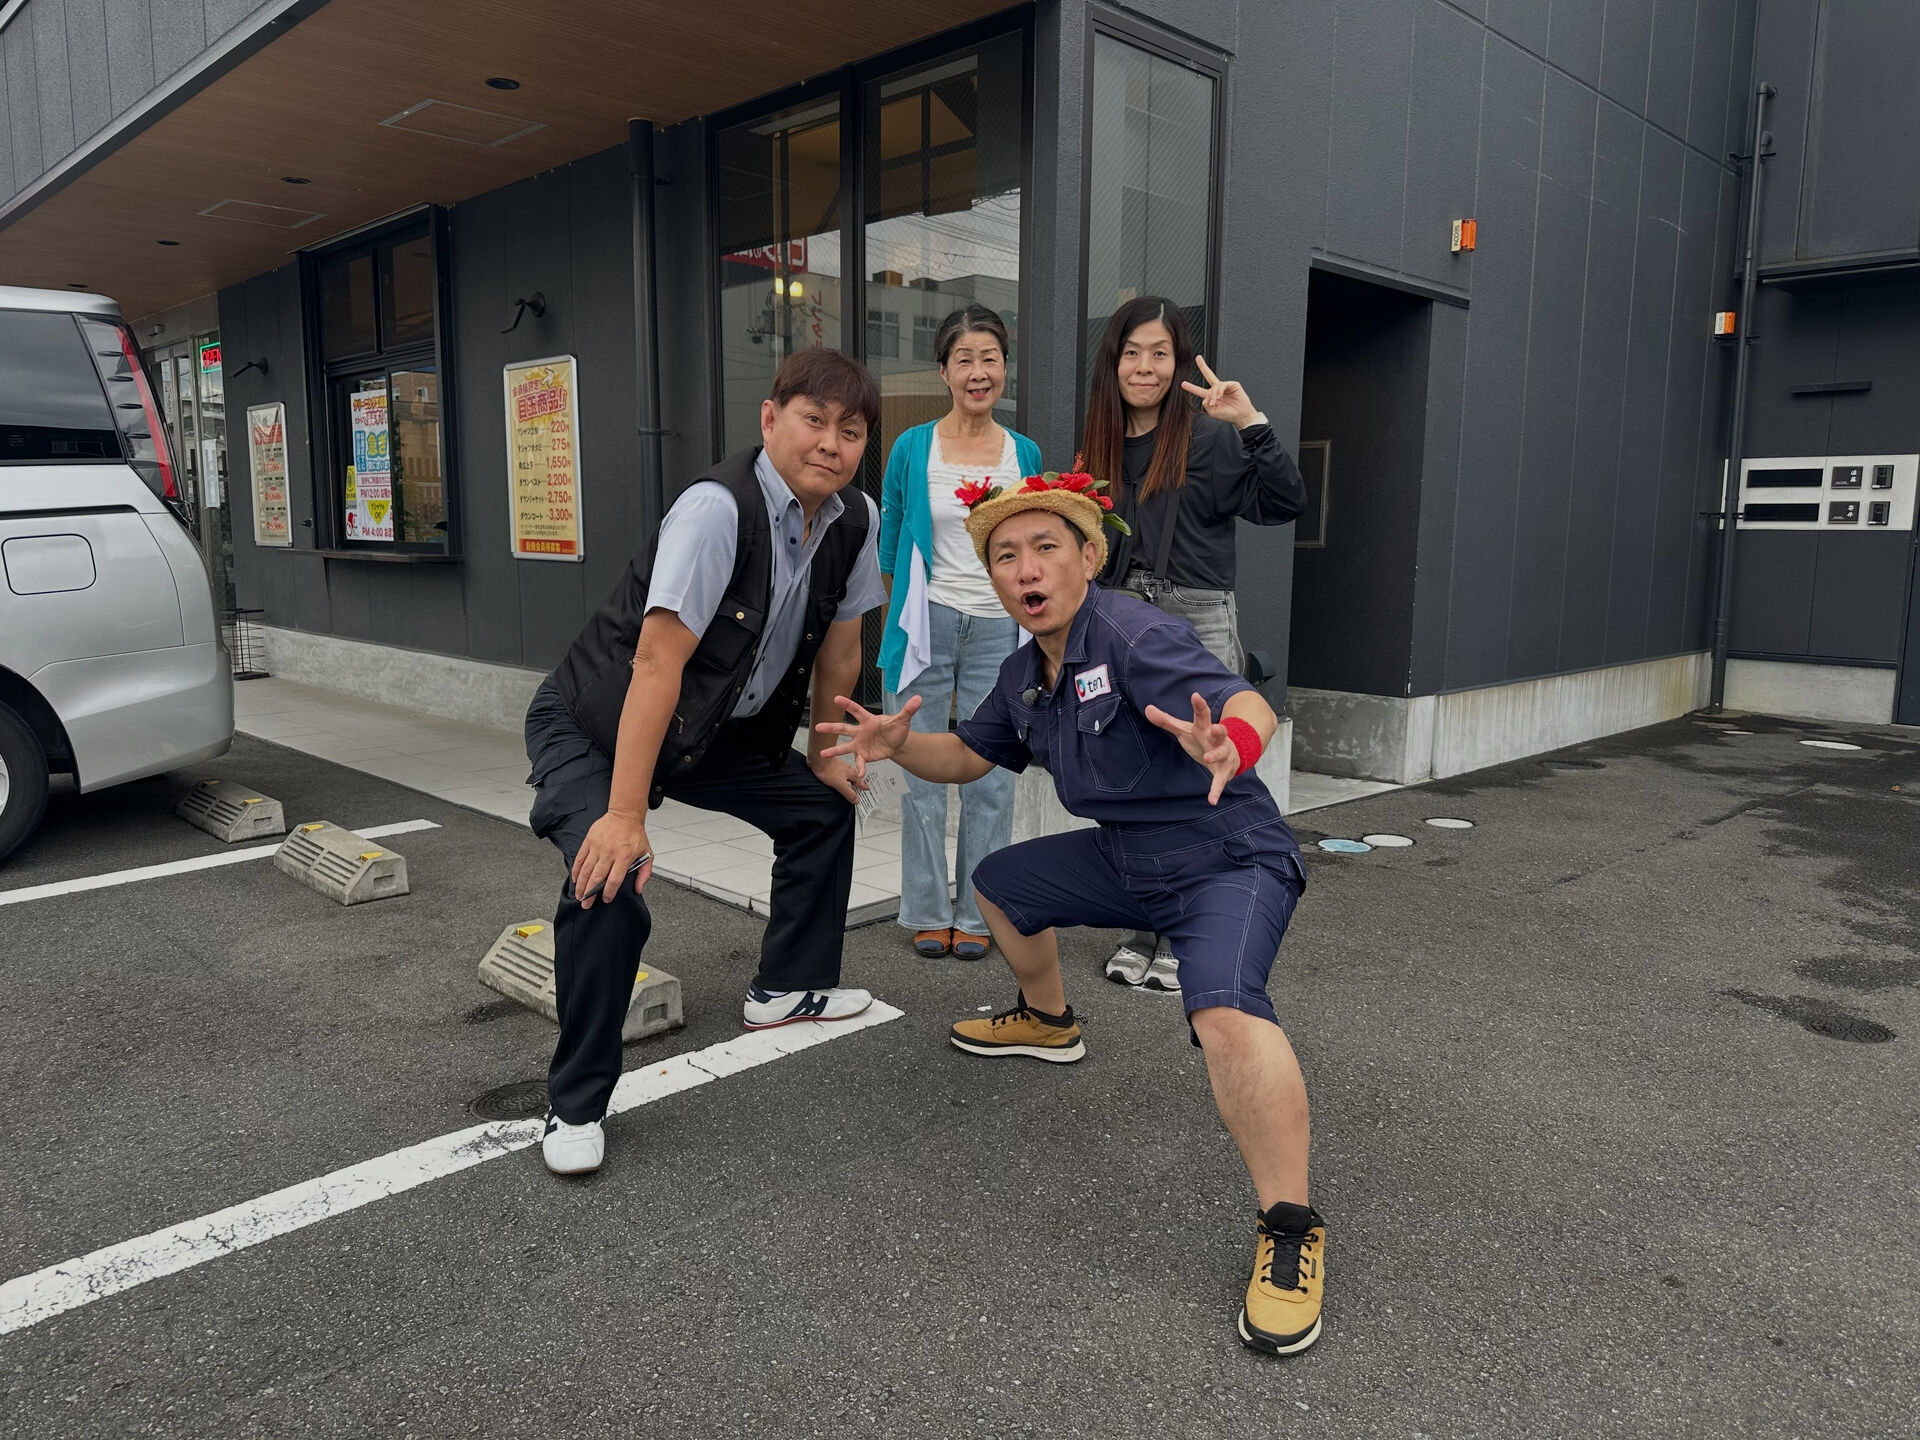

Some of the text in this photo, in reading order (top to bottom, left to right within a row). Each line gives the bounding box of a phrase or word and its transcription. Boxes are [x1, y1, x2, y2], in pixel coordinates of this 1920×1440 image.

[520, 512, 543, 520] ダウンコート
[1088, 676, 1103, 692] ten
